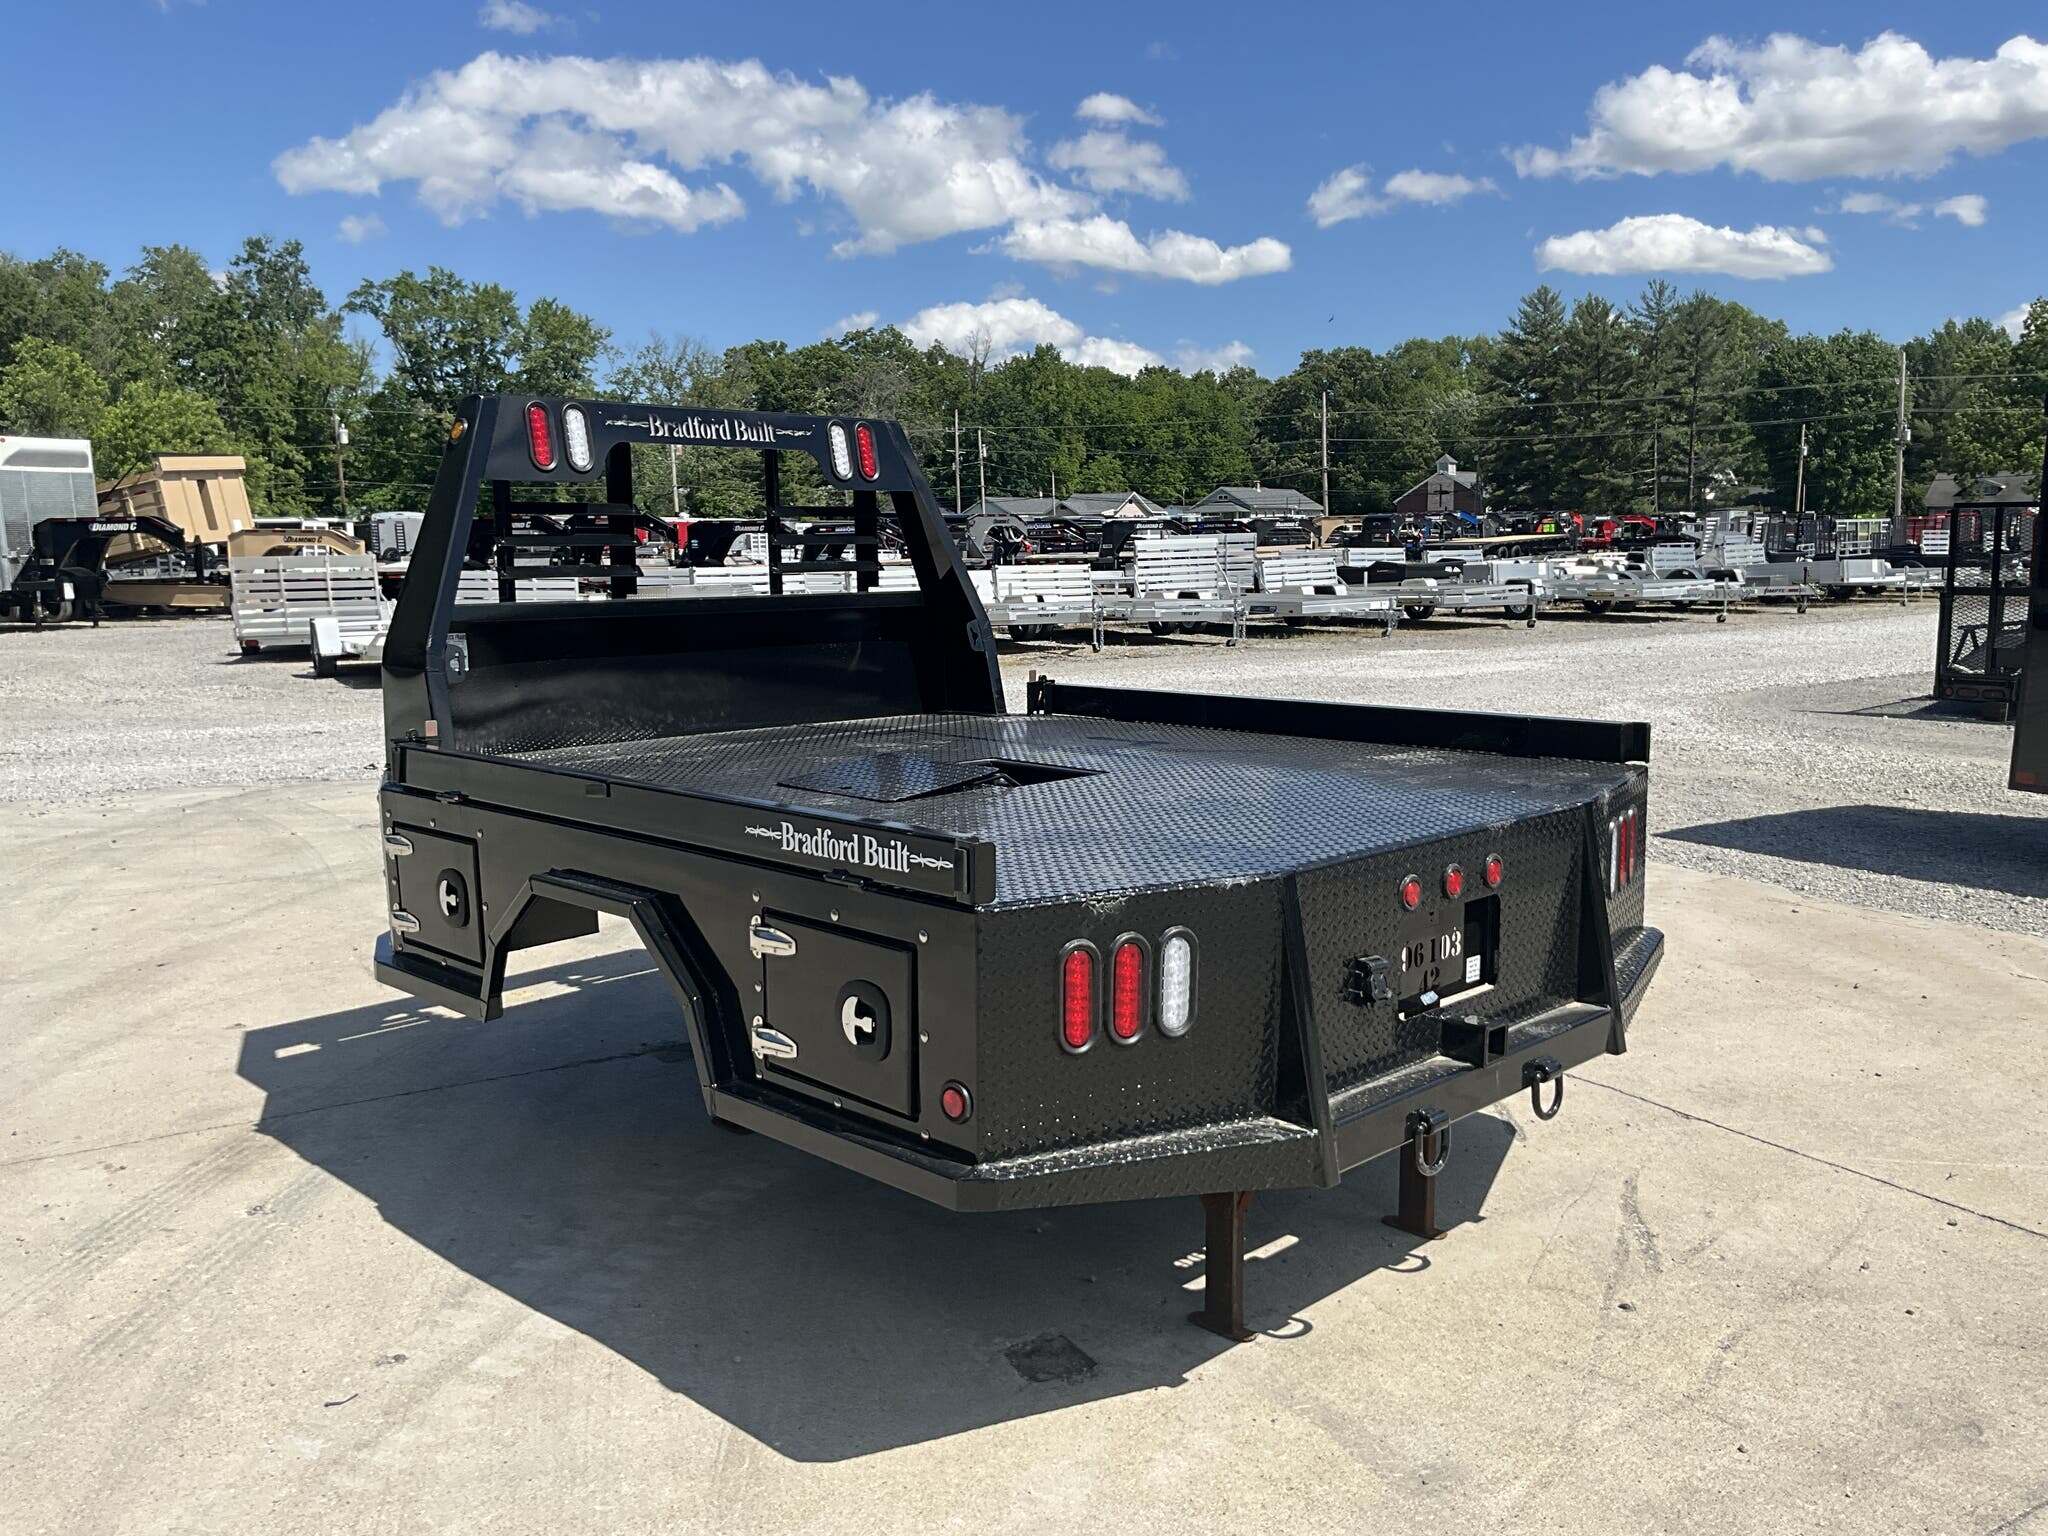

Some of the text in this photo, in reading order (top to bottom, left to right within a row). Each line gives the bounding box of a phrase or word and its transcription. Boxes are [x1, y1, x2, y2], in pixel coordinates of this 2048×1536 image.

[648, 413, 776, 443] Bradford Built
[91, 522, 137, 531] DIAMOND C
[779, 821, 911, 873] Bradford Built
